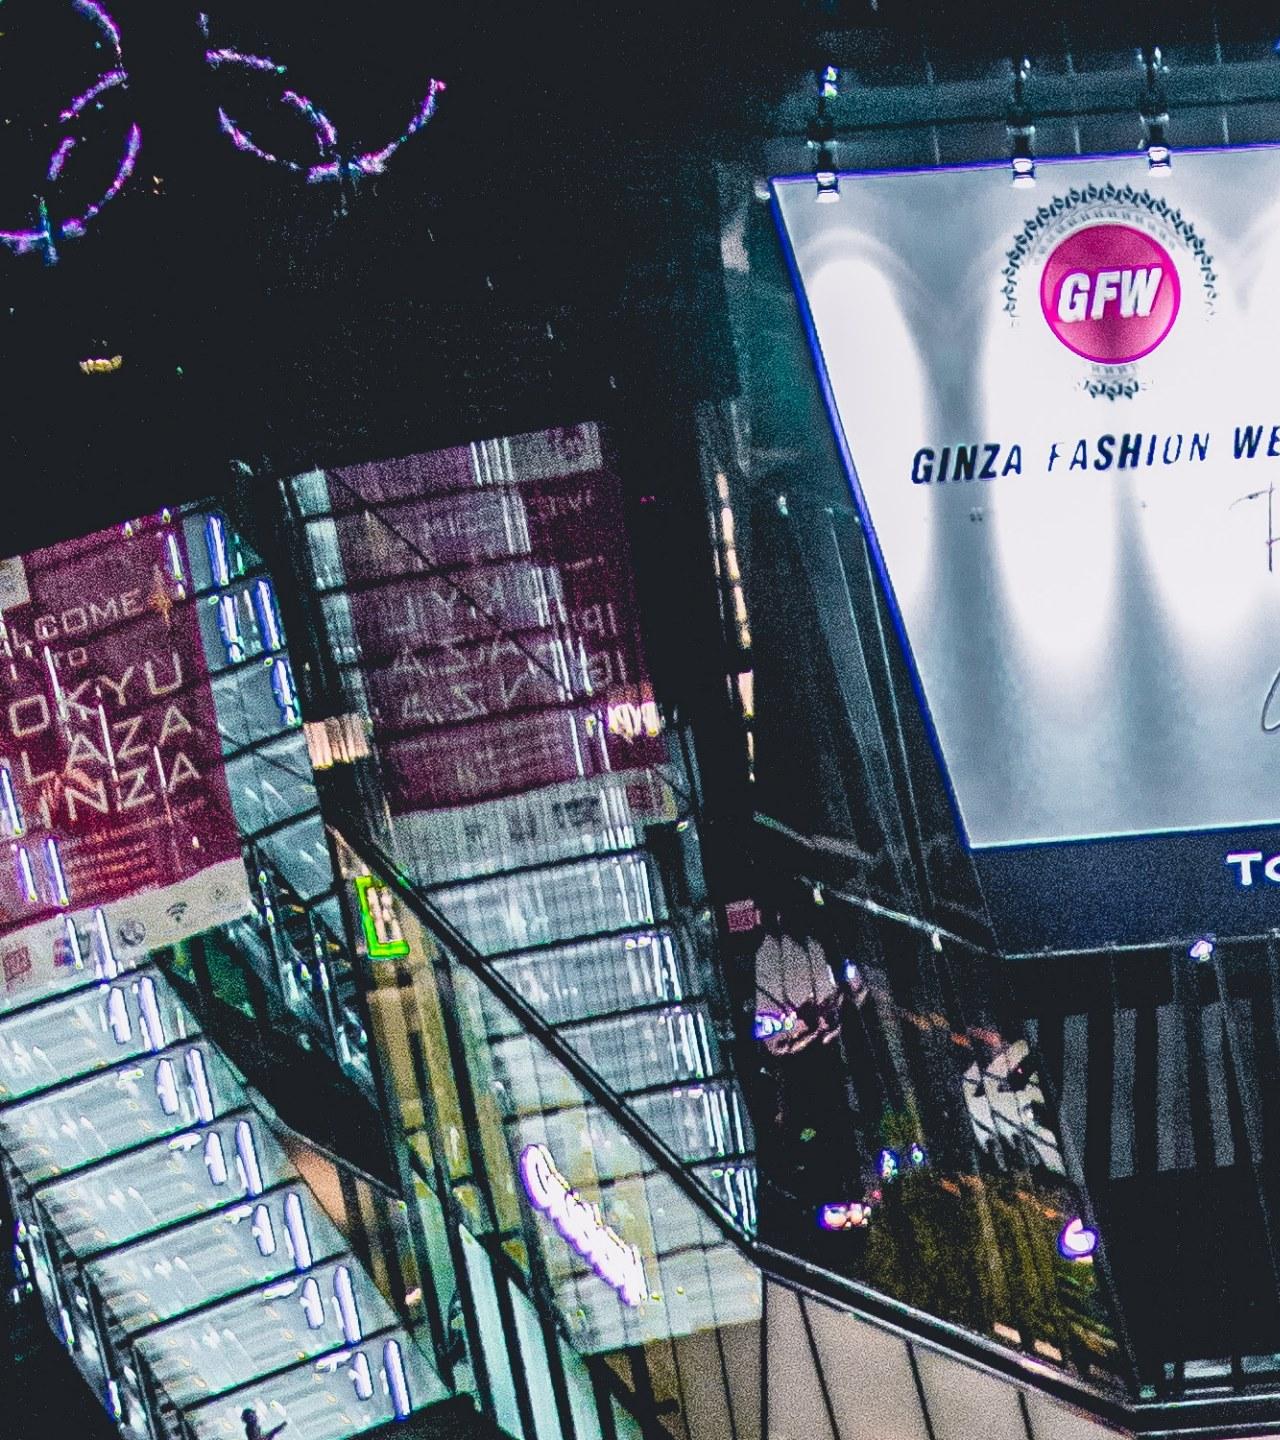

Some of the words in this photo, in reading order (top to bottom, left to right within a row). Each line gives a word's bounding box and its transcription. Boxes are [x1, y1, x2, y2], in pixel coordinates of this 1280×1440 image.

[1057, 267, 1162, 324] GFW
[911, 443, 1023, 486] GINZA
[1047, 431, 1209, 473] FASHION
[8, 652, 183, 738] OKYU
[20, 705, 192, 786] LAZA
